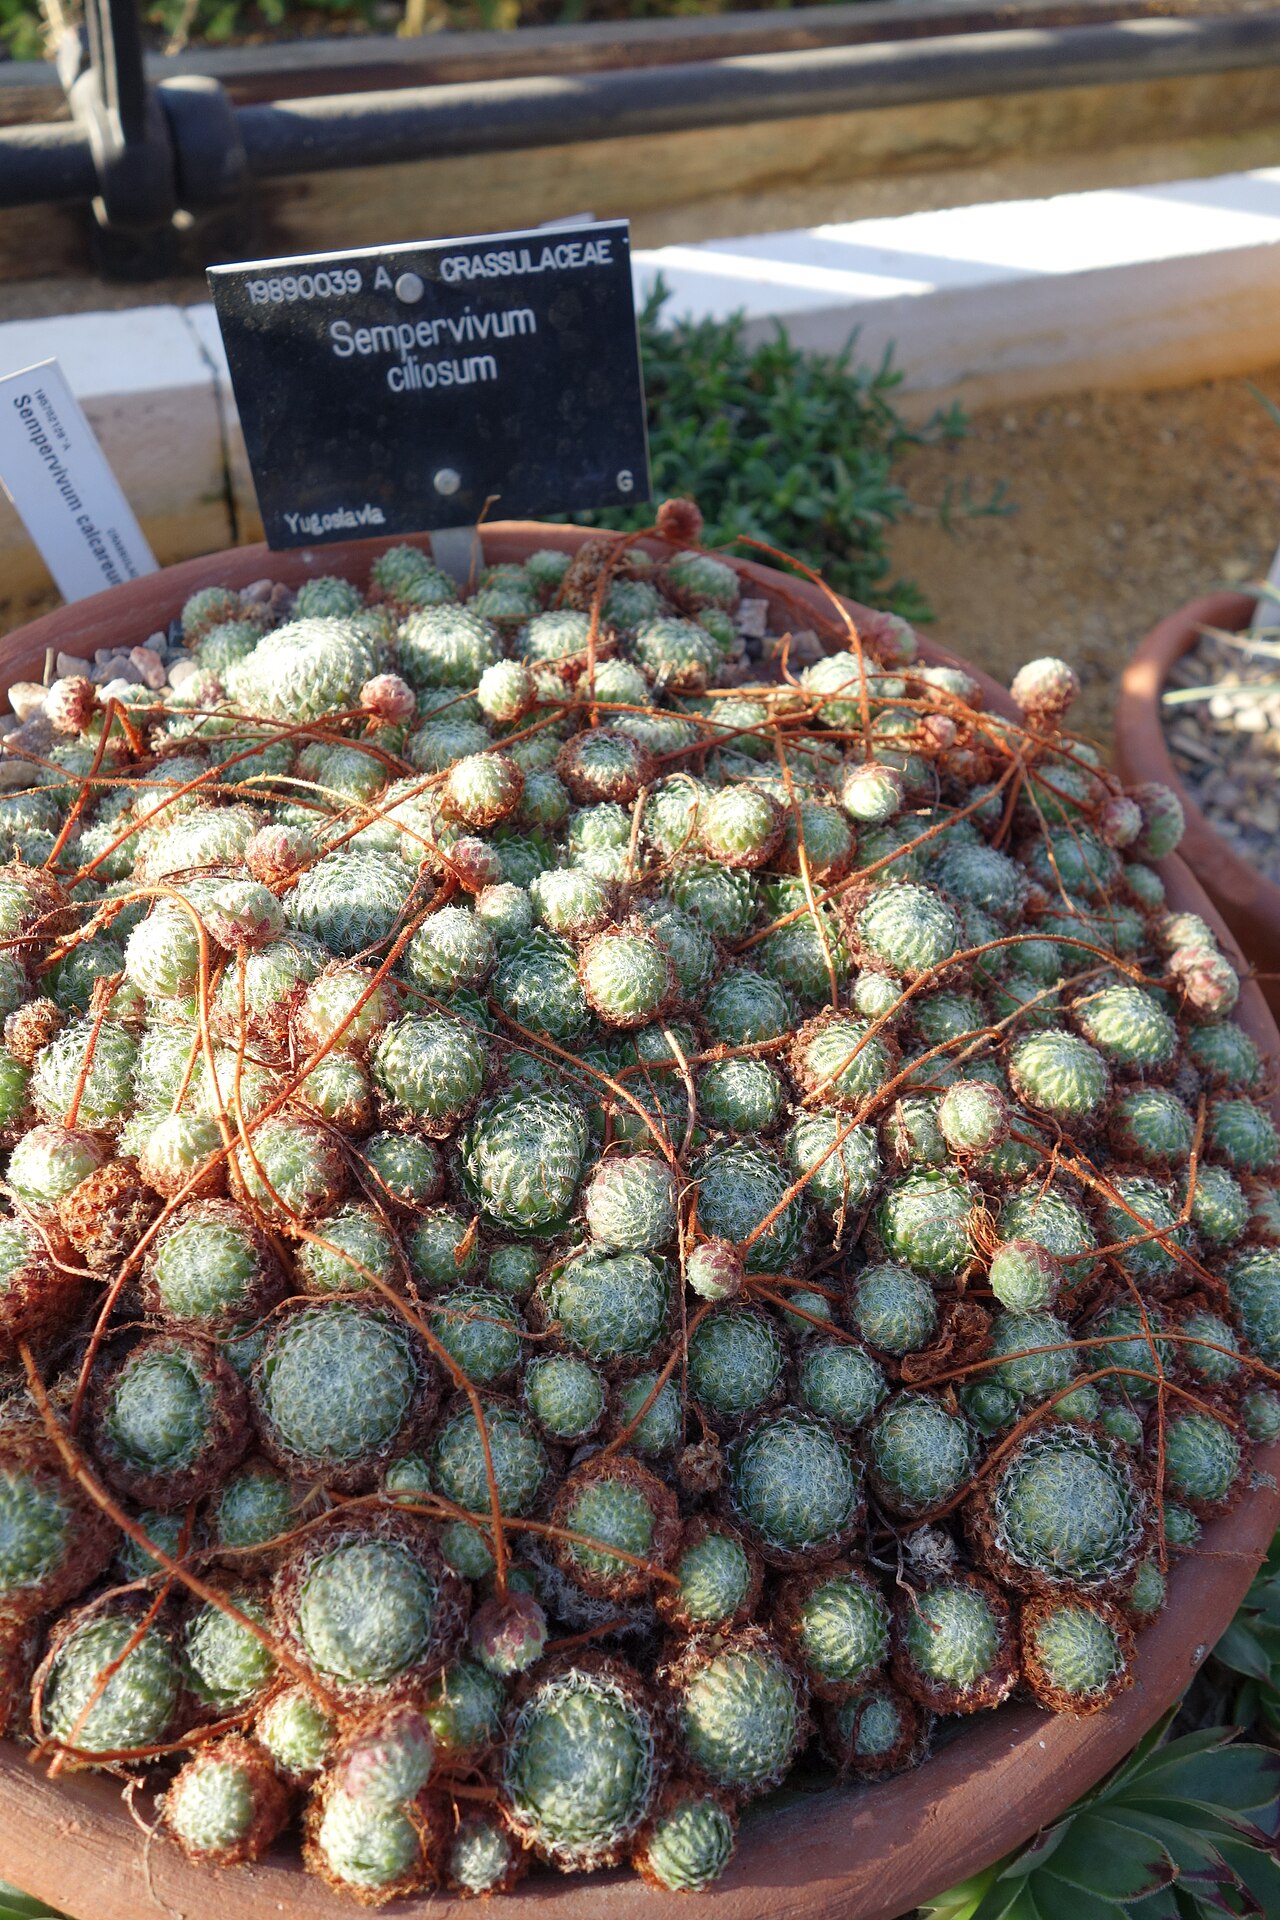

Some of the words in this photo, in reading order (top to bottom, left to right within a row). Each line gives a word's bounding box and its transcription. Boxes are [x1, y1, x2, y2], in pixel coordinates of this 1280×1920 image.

[440, 239, 613, 282] CRASSULACEAE
[245, 268, 362, 305] 19890039
[374, 265, 393, 290] A
[329, 306, 537, 359] Sempervivum
[387, 353, 498, 393] ciliosum
[13, 394, 83, 512] Sempervivum
[616, 469, 634, 492] G
[283, 503, 386, 536] Yugoslavia
